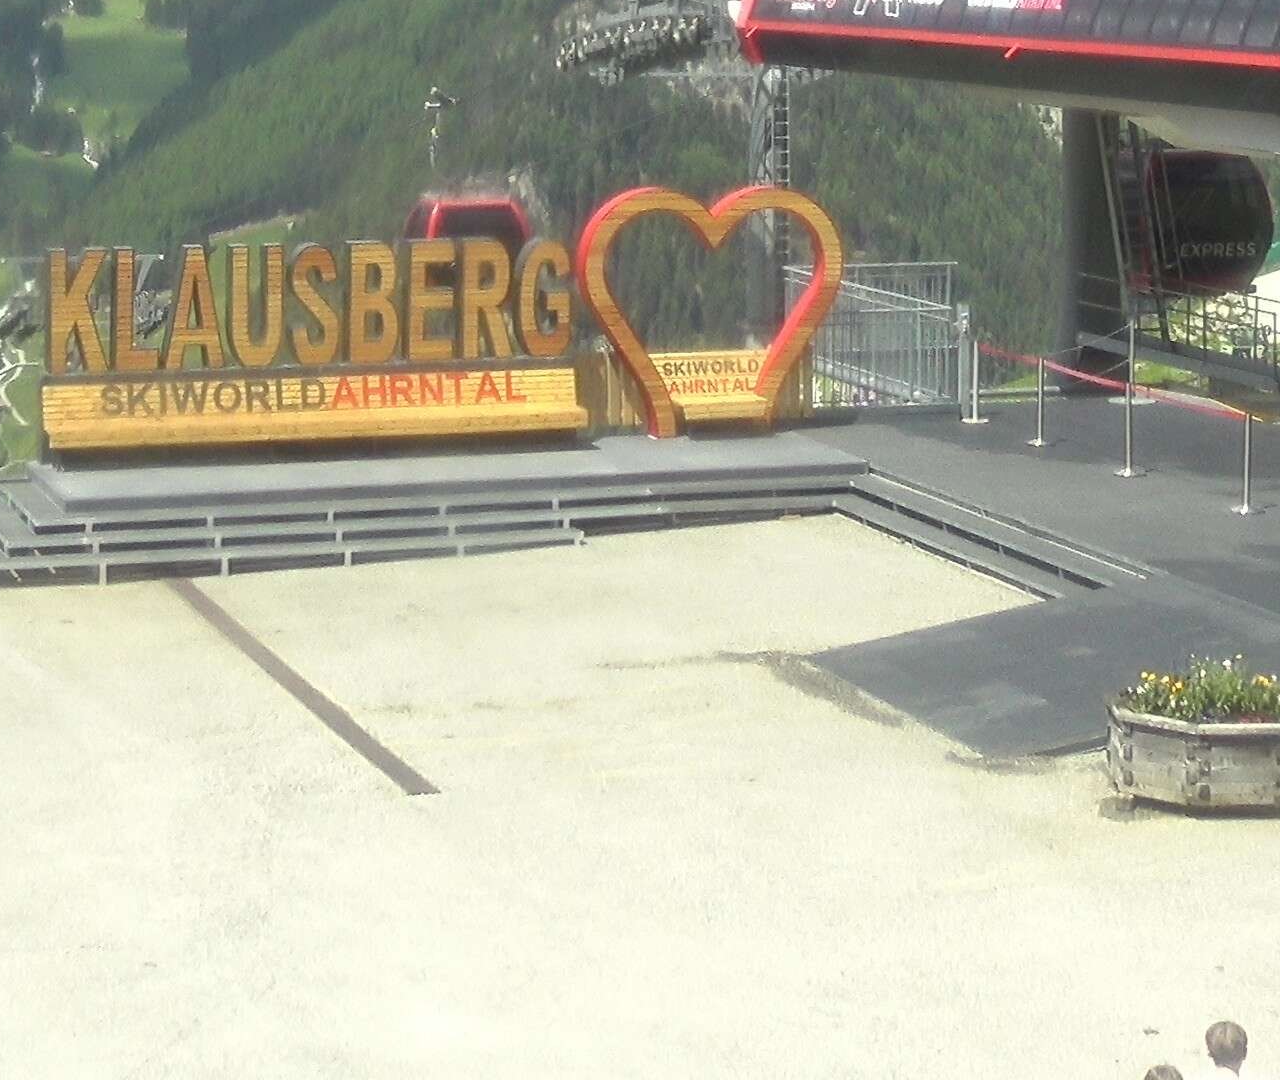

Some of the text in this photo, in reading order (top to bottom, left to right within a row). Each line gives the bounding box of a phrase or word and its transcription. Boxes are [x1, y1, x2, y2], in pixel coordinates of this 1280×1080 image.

[1179, 241, 1257, 258] EXPRESS
[46, 237, 573, 375] KLAUSBERG
[662, 359, 760, 377] SKIWORLD
[100, 370, 528, 417] SKIWORLD AHRNTAL
[669, 376, 758, 396] AHRNTAL
